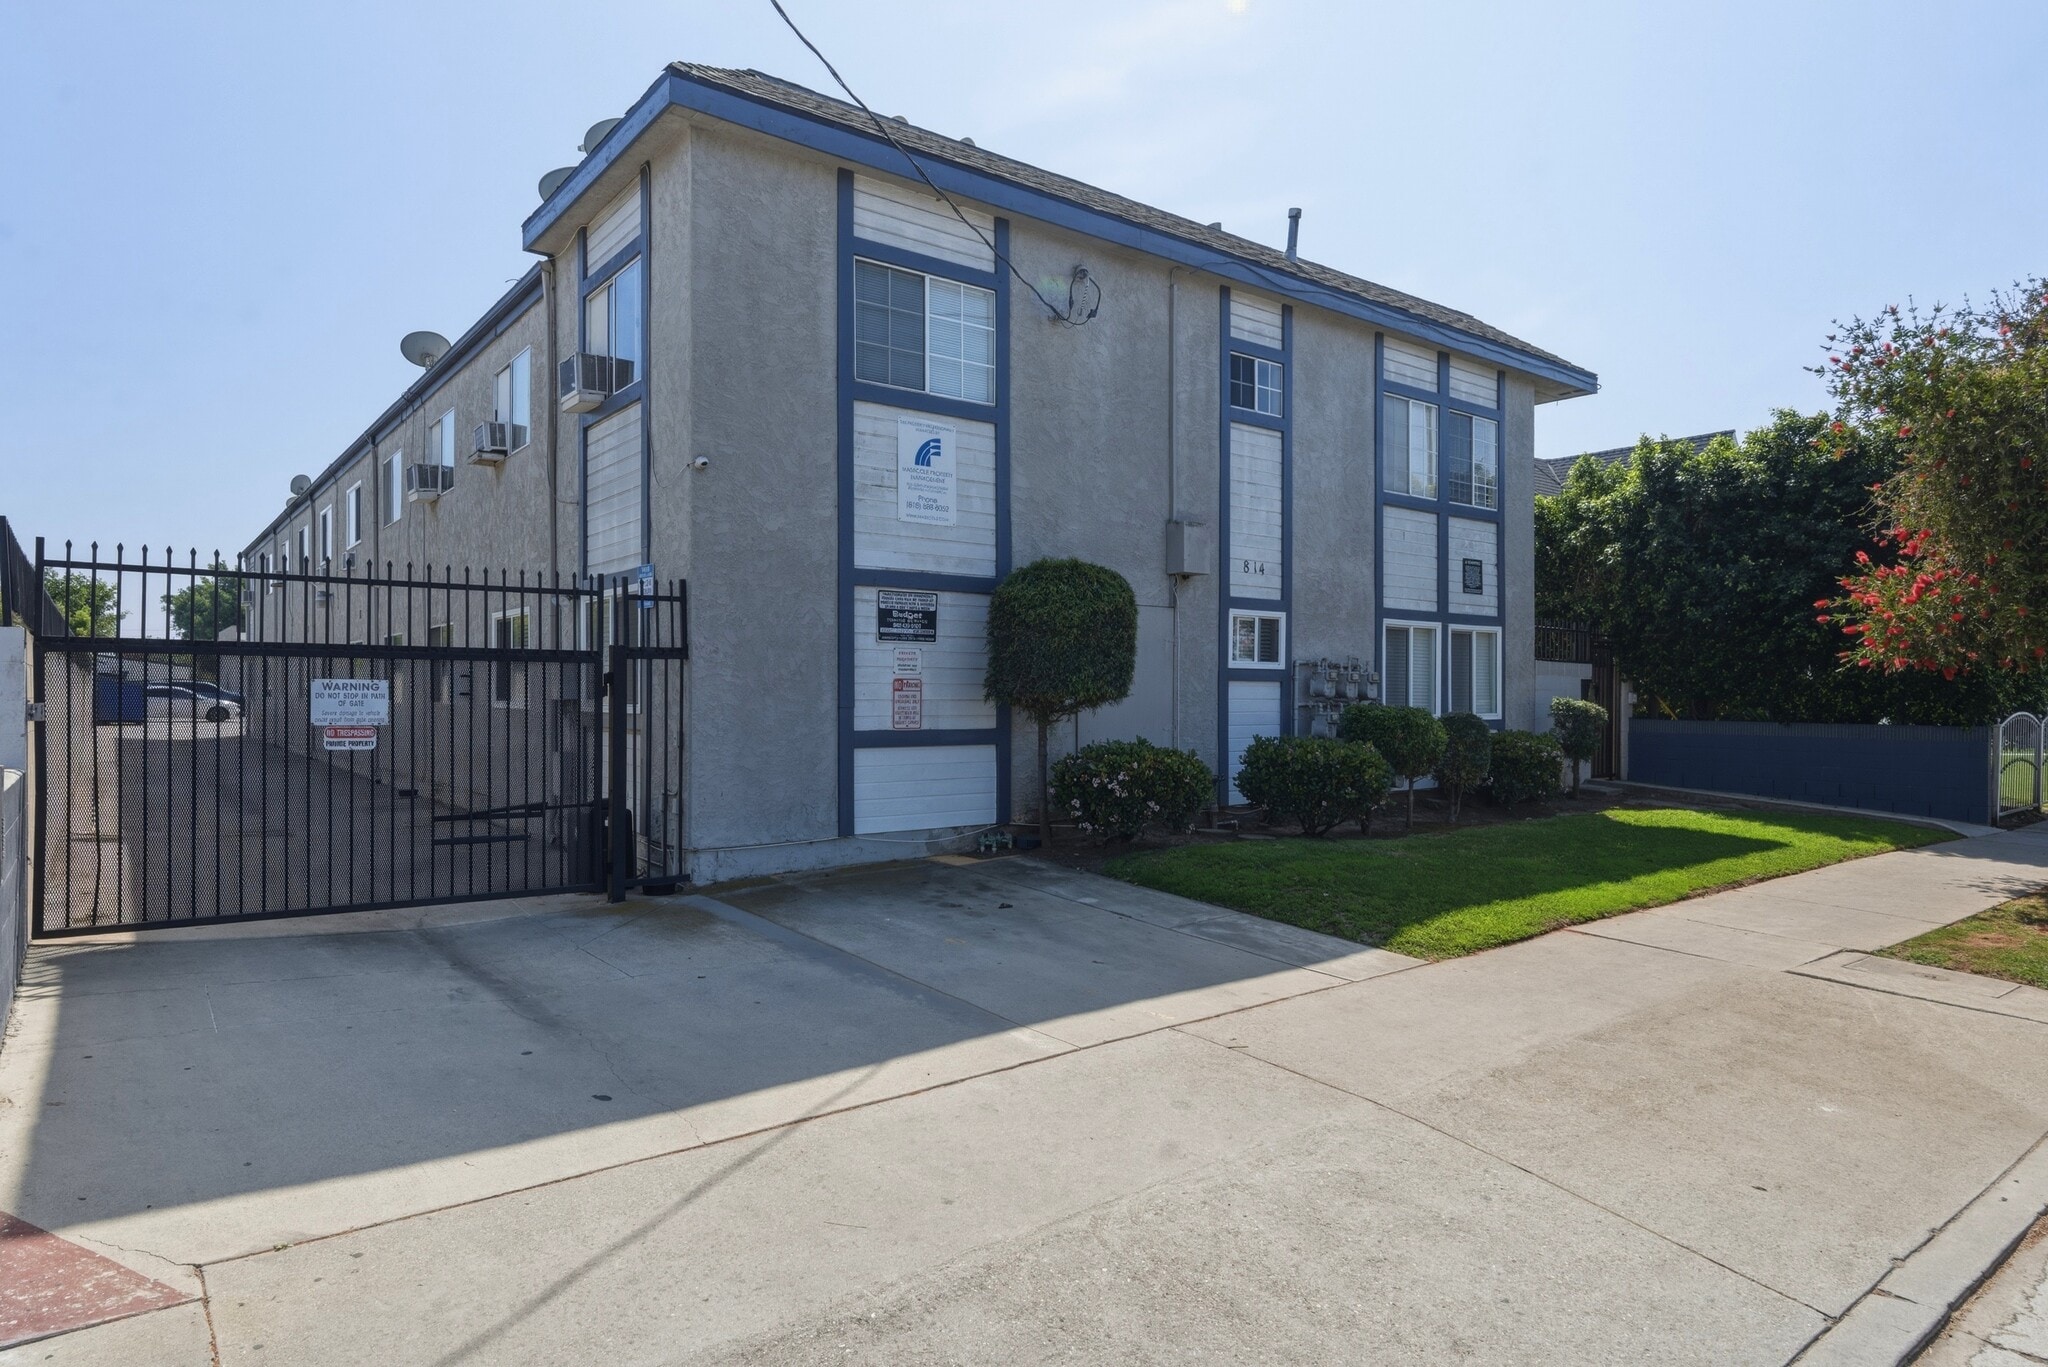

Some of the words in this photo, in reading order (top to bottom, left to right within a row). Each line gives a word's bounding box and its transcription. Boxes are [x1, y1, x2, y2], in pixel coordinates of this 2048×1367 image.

[918, 494, 938, 504] Phone
[1243, 559, 1265, 575] 814
[892, 610, 923, 619] Budget
[322, 682, 380, 692] WARNING
[326, 729, 336, 737] NO
[337, 729, 375, 737] TRESPASSING
